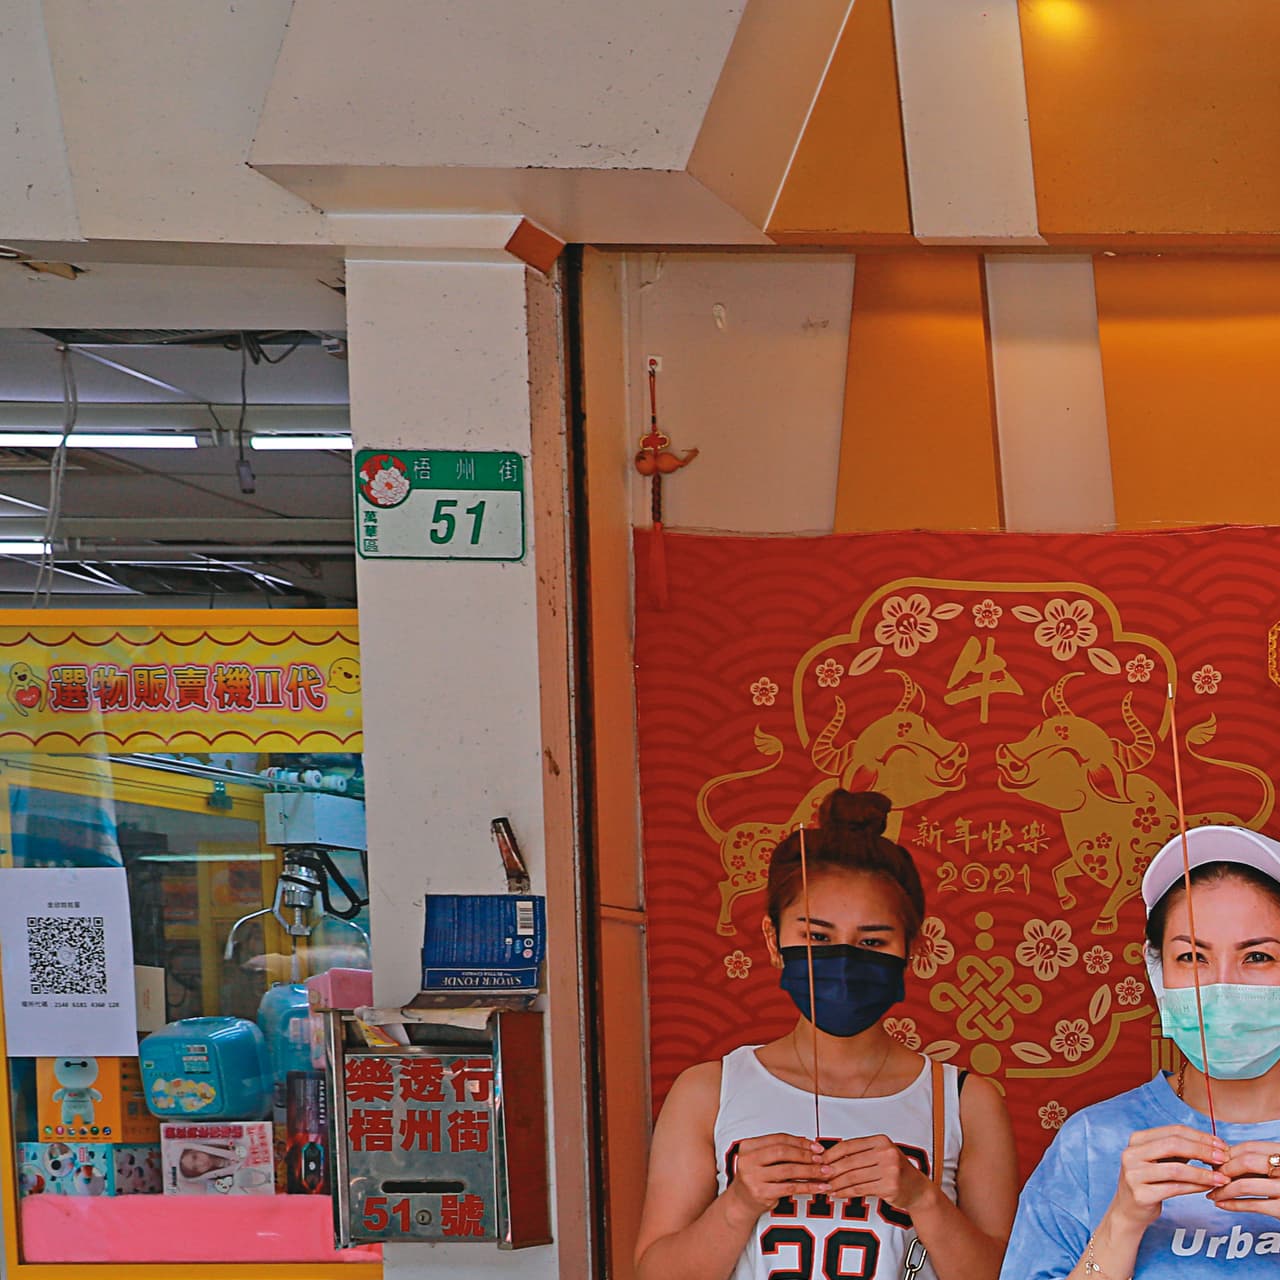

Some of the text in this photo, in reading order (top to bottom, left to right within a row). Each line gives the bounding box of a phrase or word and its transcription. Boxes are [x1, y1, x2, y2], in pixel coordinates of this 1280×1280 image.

[413, 457, 517, 482] 梧州街
[363, 510, 379, 552] 萬華區
[430, 500, 486, 544] 51
[944, 636, 1024, 723] 牛
[911, 817, 1051, 855] 新年快樂
[936, 864, 1032, 895] 2021
[345, 1058, 492, 1104] 樂透行
[347, 1109, 490, 1154] 梧州街
[362, 1195, 486, 1237] 51 號
